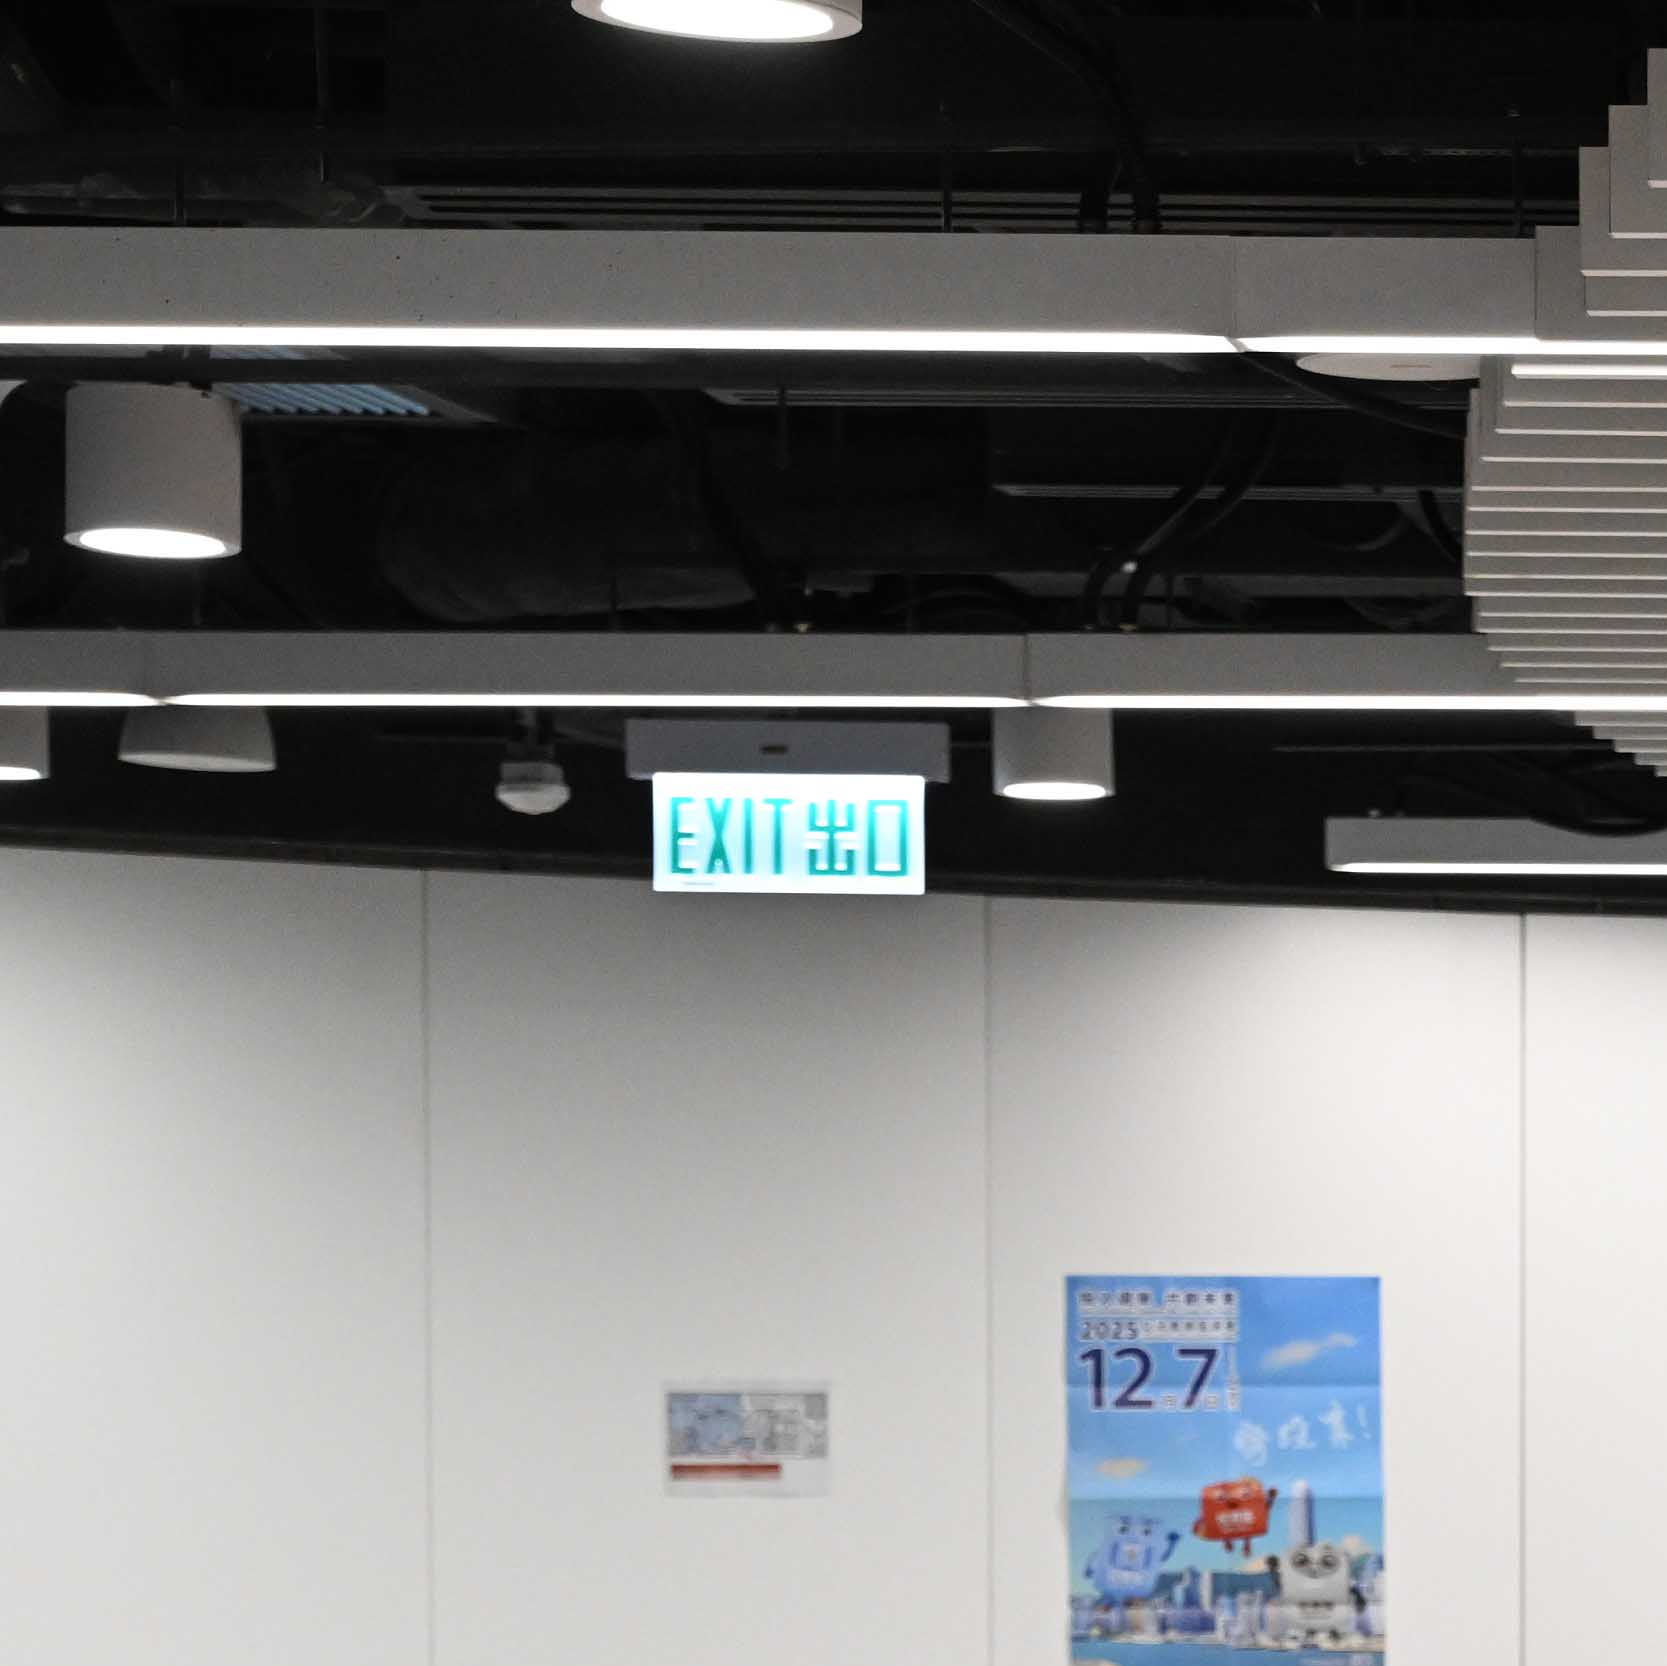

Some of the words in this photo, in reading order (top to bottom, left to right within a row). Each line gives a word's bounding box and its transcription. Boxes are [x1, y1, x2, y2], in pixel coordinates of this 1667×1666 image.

[670, 797, 794, 876] EXIT
[806, 799, 910, 878] 出口
[1080, 1321, 1138, 1340] 2025
[1080, 1347, 1153, 1408] 12
[1178, 1348, 1218, 1408] 7
